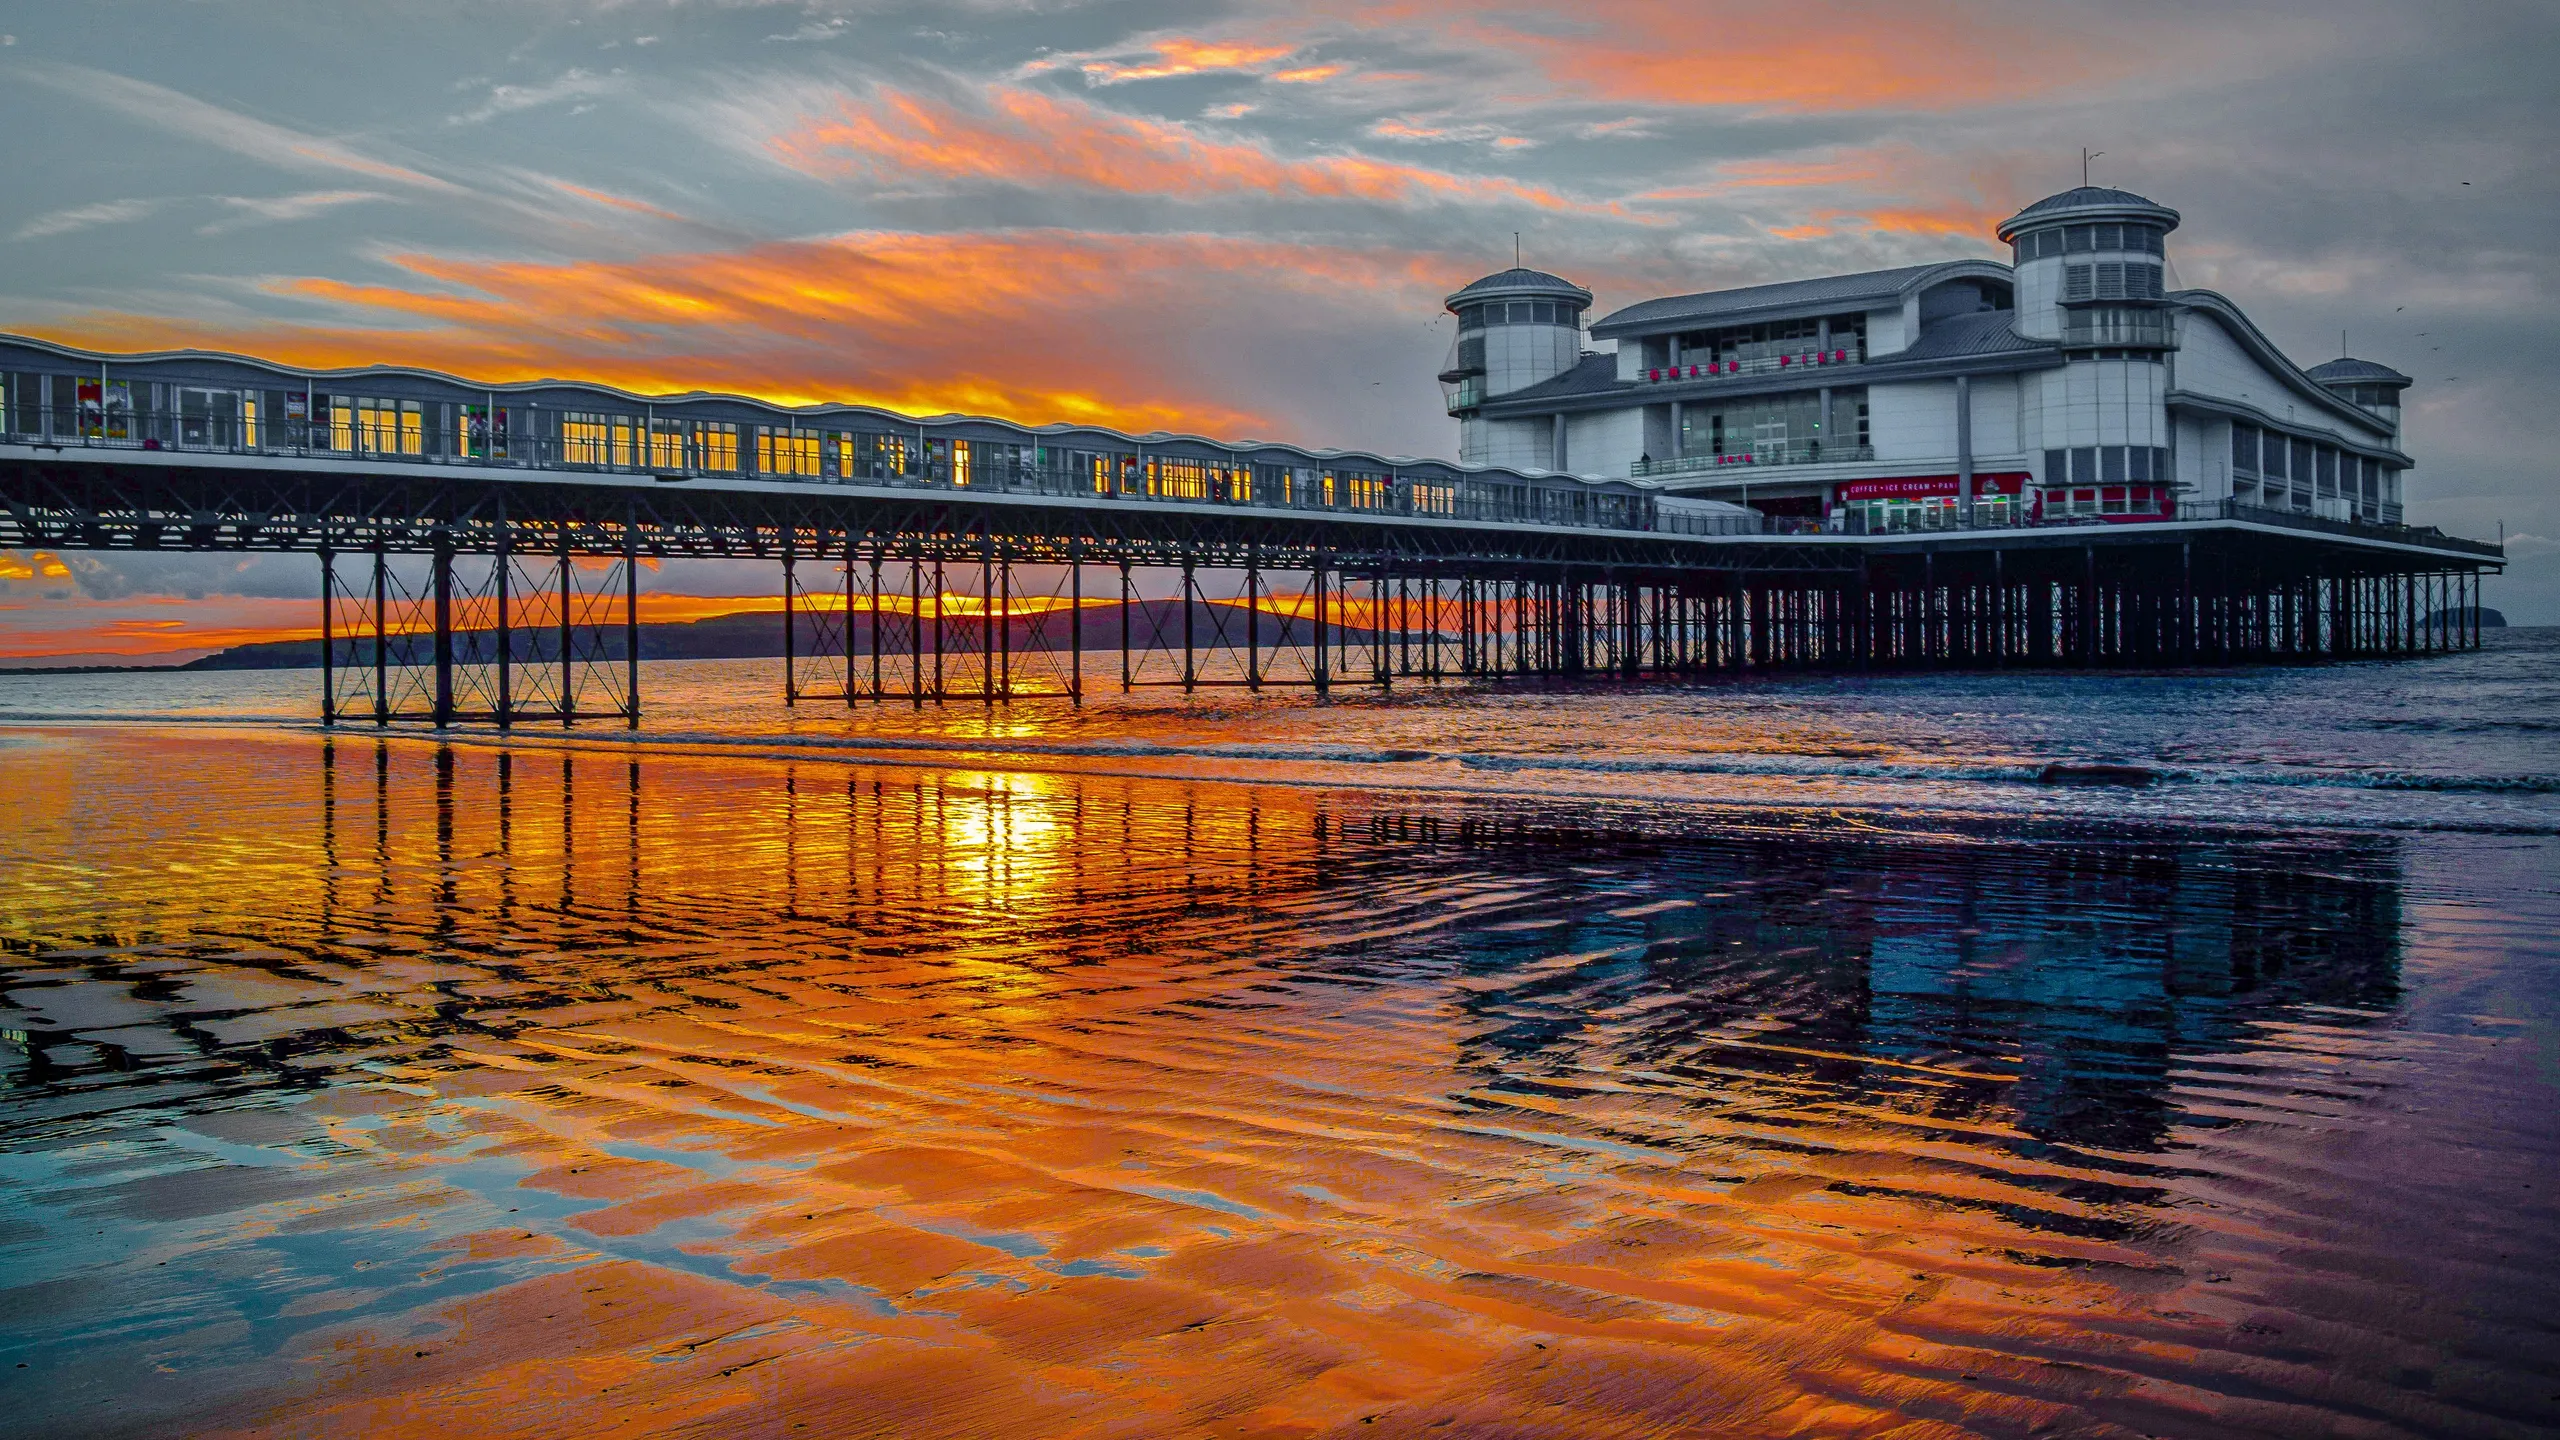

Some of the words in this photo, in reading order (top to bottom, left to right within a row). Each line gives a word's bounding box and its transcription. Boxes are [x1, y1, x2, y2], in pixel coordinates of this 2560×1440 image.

[1649, 360, 1739, 381] GRAND
[1780, 349, 1845, 367] PIER
[1850, 485, 1878, 493] COFFEE
[1902, 483, 1930, 491] CREAM
